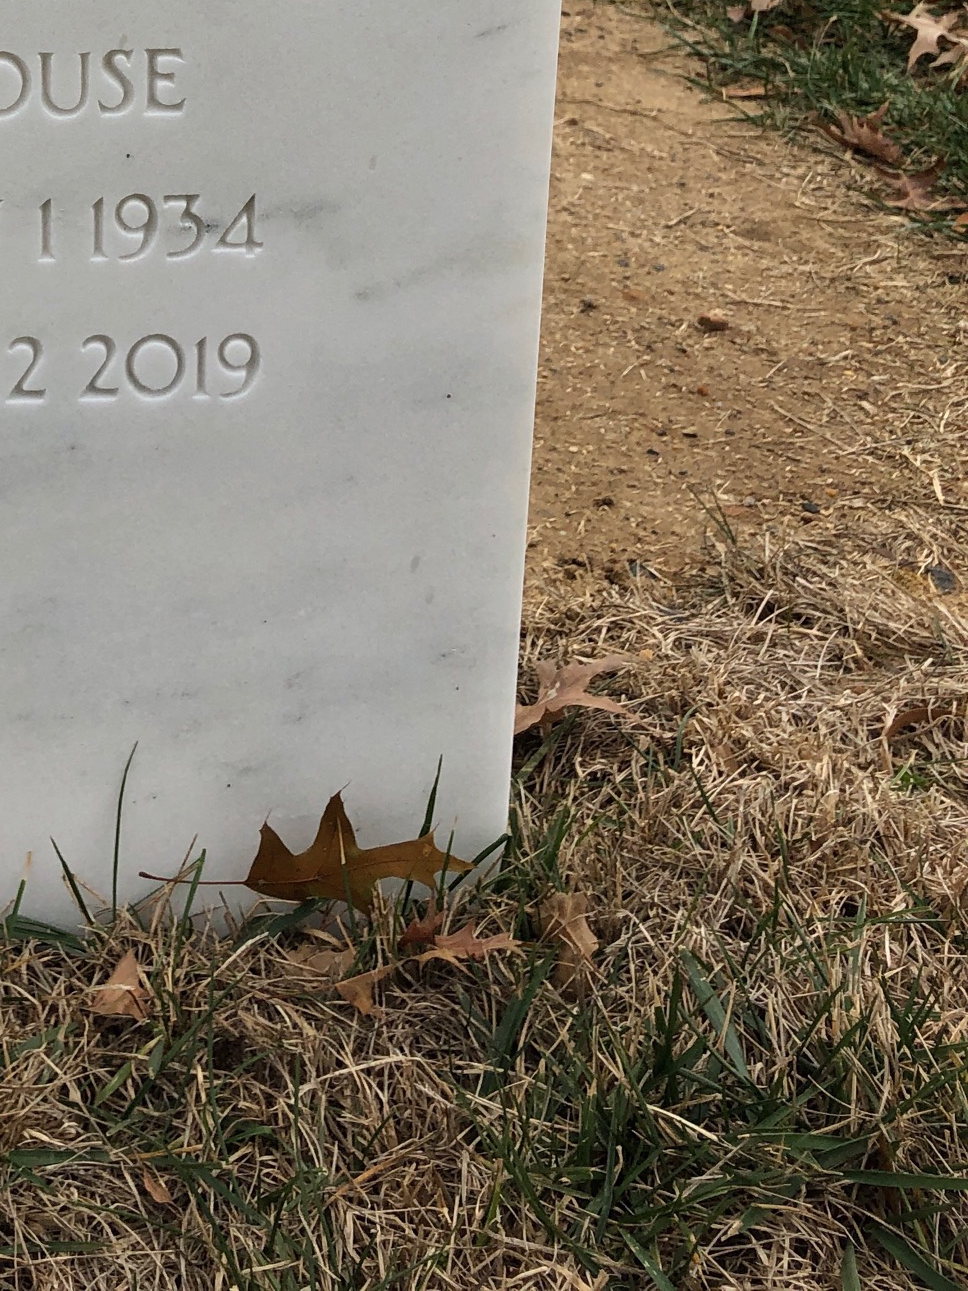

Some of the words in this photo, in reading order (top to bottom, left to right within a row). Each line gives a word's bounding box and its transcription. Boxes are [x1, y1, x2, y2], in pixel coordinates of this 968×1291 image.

[37, 197, 56, 262] 1
[90, 193, 264, 263] 1934
[77, 332, 262, 402] 2019
